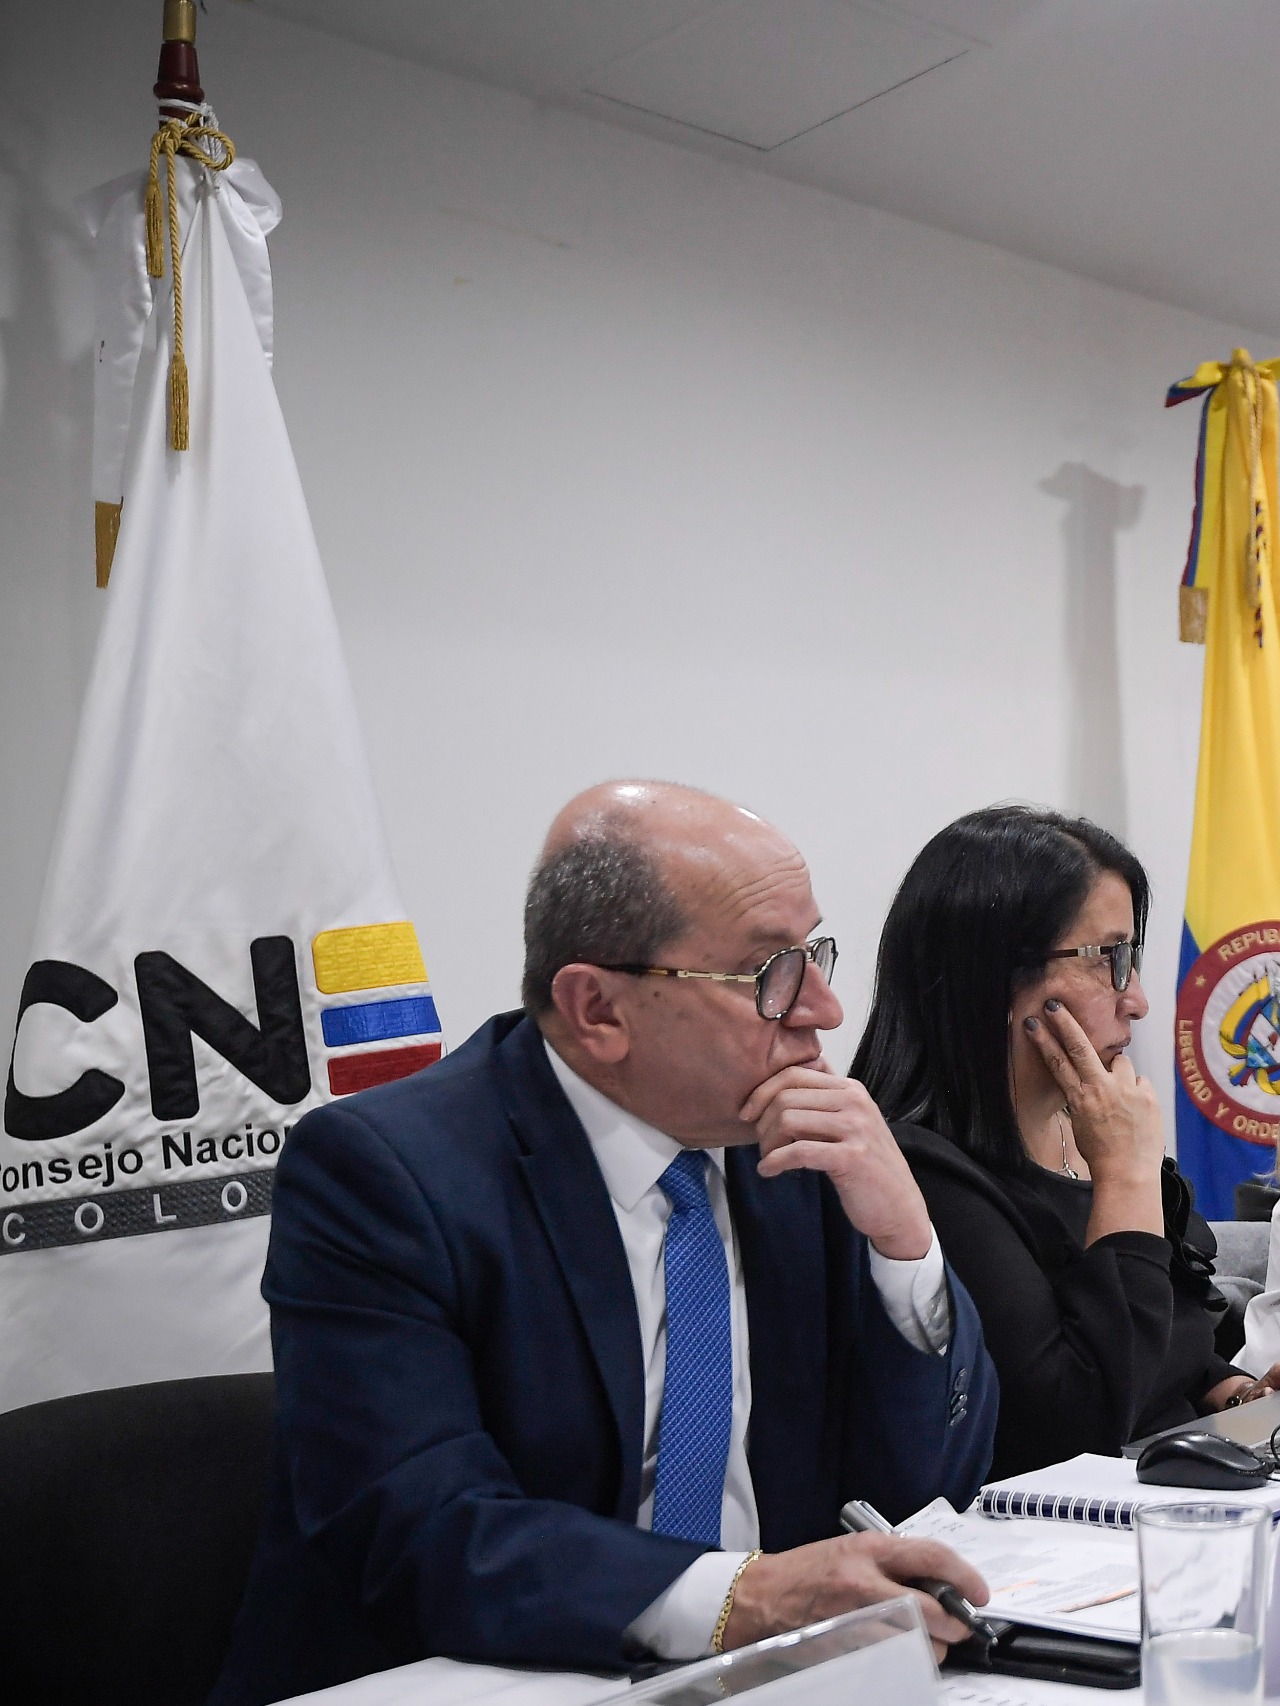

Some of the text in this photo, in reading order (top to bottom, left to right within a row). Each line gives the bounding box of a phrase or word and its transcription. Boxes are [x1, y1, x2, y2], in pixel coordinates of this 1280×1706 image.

[1179, 1020, 1212, 1101] LIBERTAD
[1214, 1102, 1230, 1119] Y
[0, 1143, 143, 1192] onsejo
